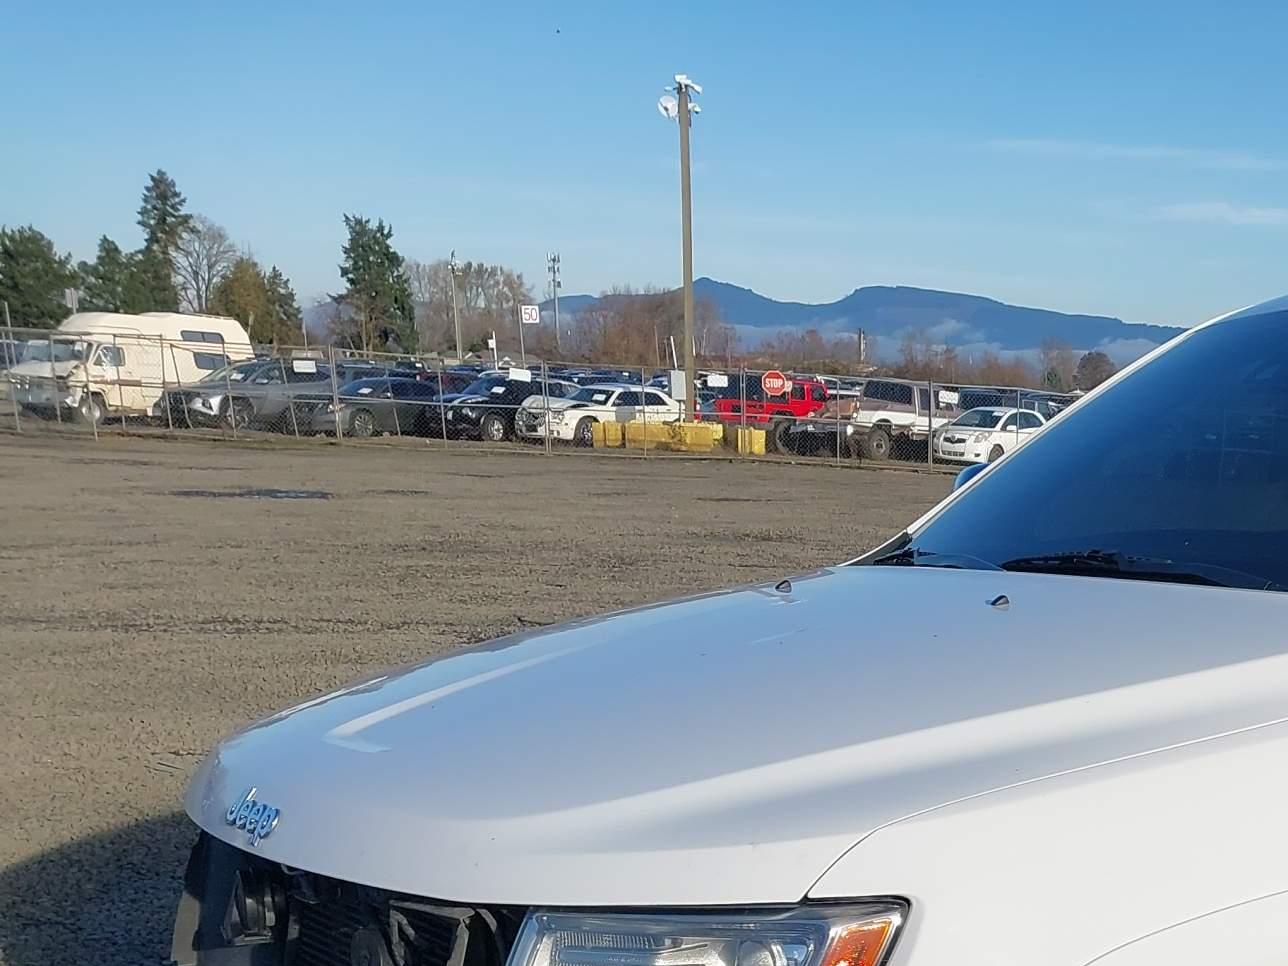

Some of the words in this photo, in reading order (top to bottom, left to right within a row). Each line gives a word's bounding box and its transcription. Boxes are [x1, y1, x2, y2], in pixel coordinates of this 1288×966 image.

[523, 307, 538, 322] 50
[765, 378, 784, 388] STOP
[225, 787, 281, 848] Jeep
